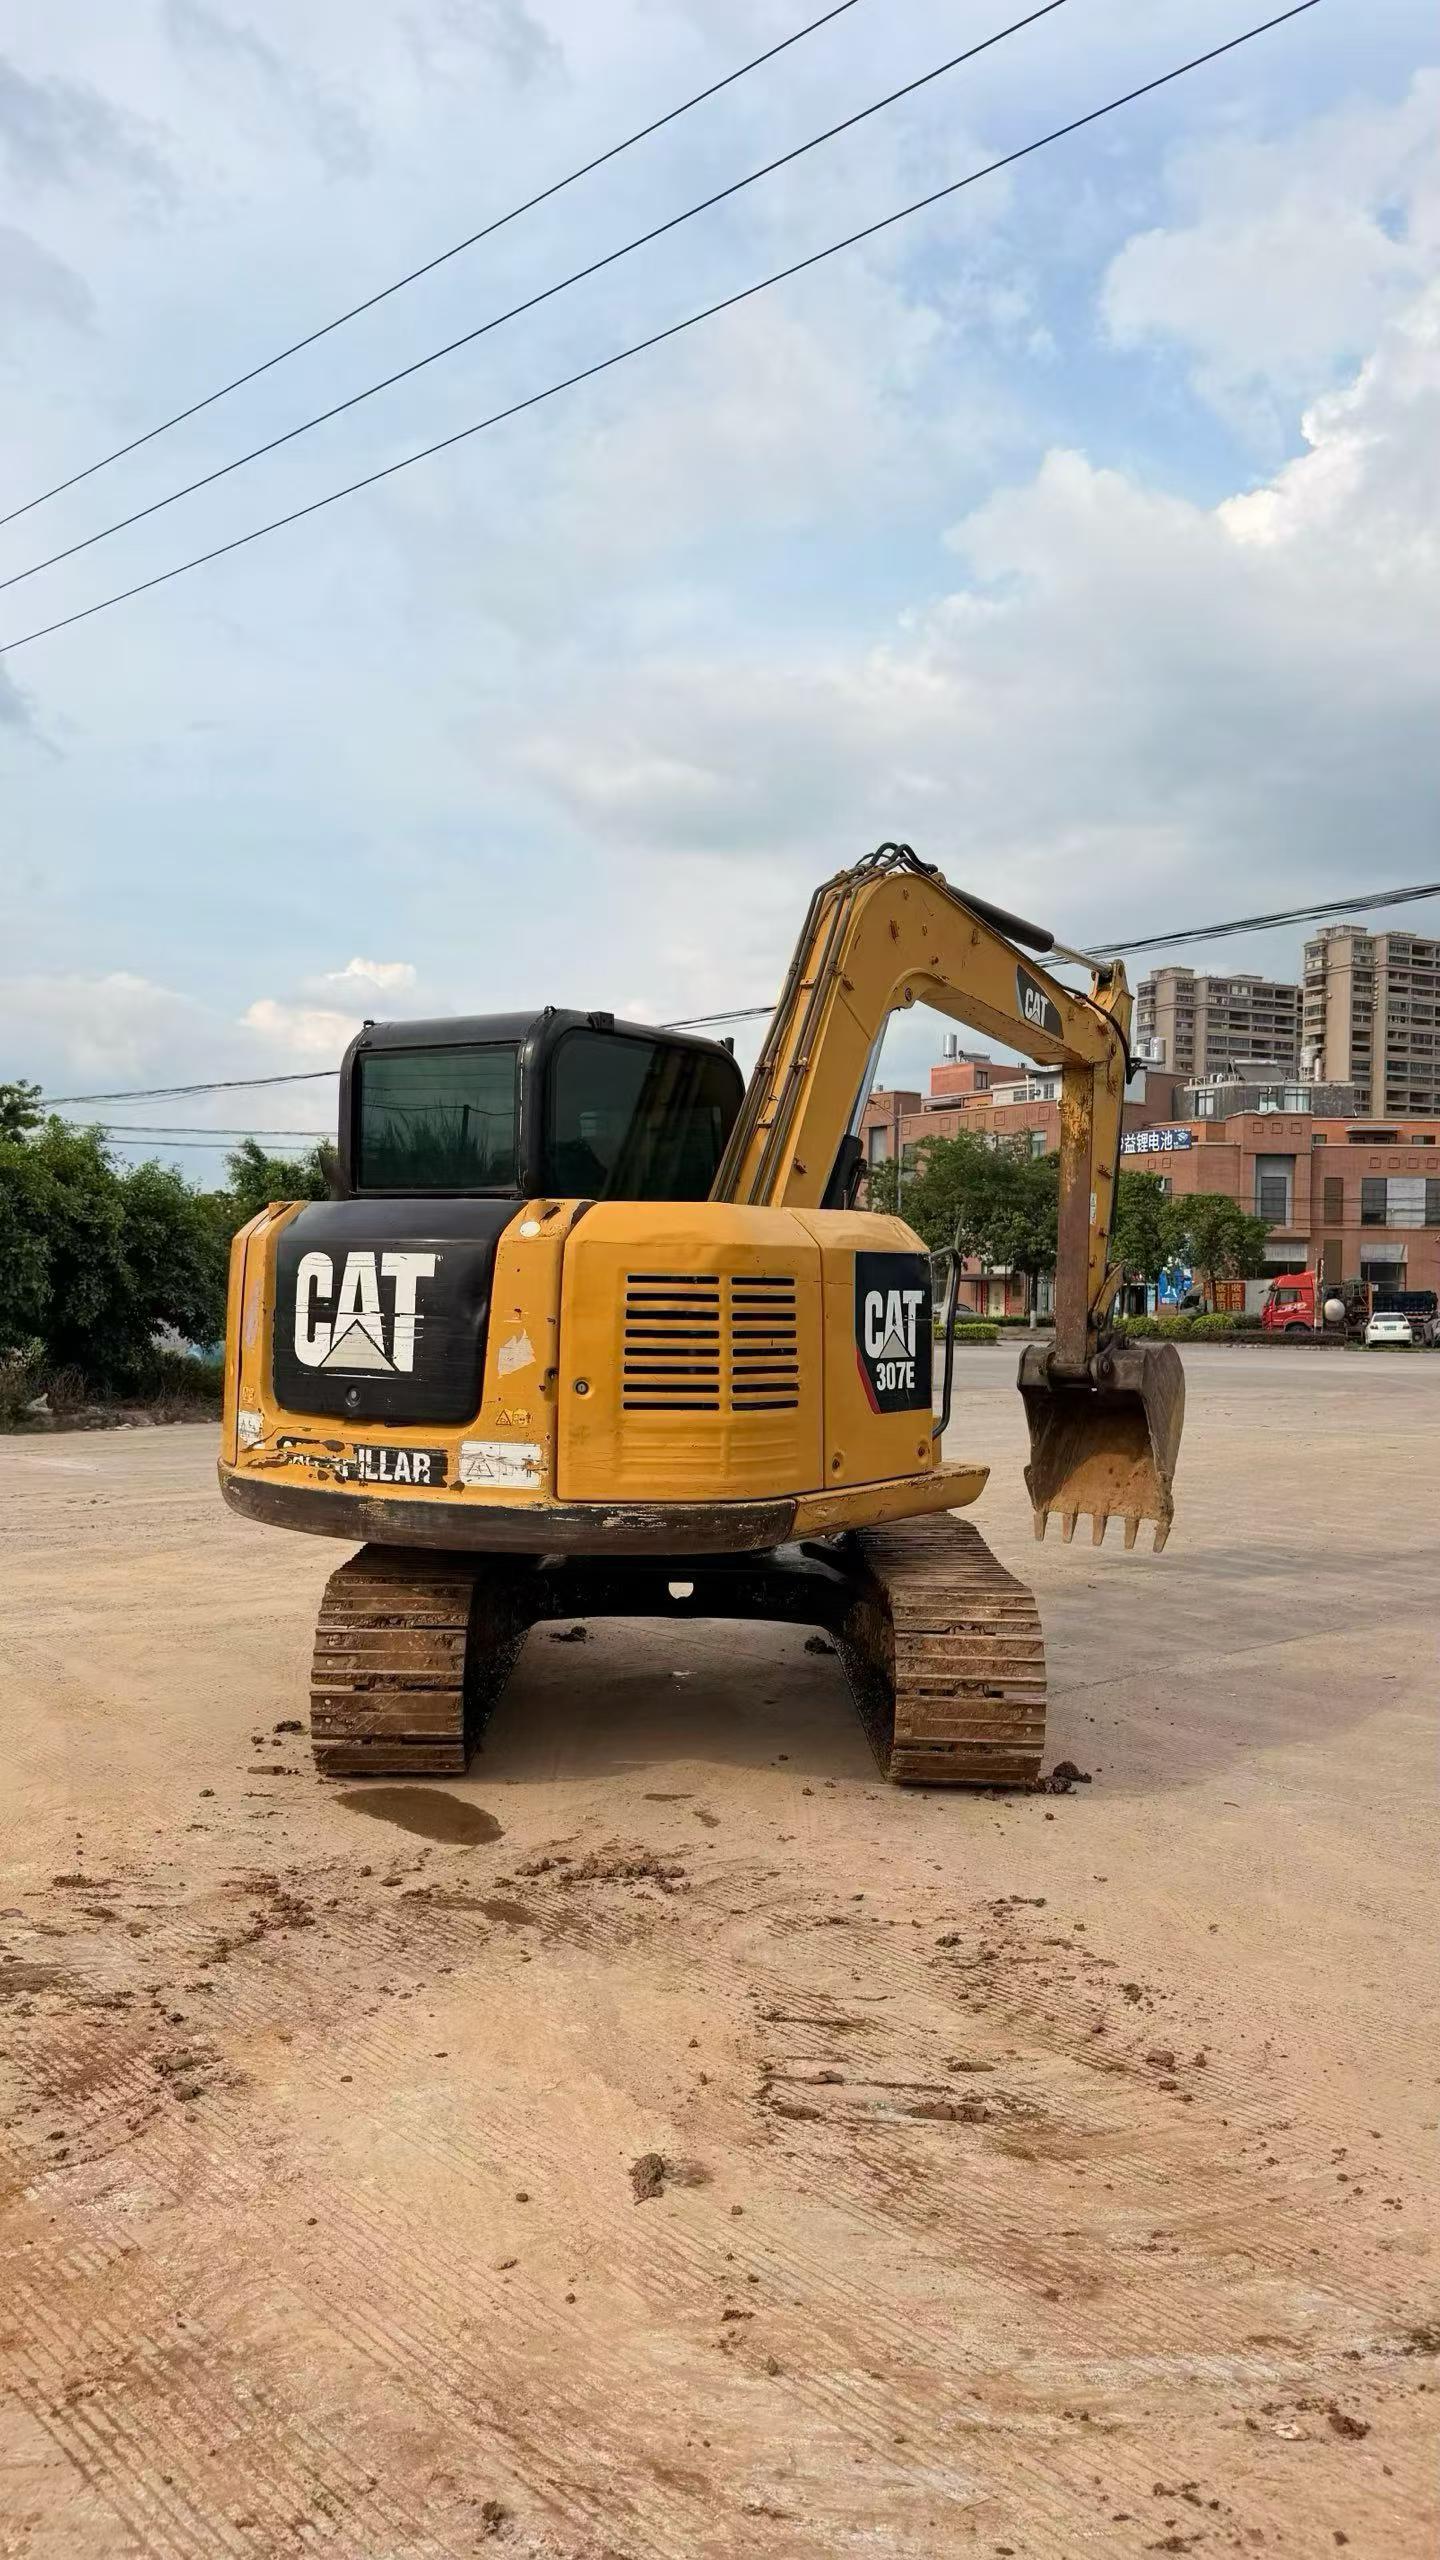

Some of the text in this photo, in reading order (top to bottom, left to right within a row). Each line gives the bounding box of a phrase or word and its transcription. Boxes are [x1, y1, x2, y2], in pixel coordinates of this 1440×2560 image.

[1025, 988, 1049, 1028] CAT
[1121, 1130, 1173, 1153] 益锂电池
[295, 1252, 436, 1371] CAT
[865, 1290, 923, 1358] CAT
[876, 1361, 915, 1391] 307E
